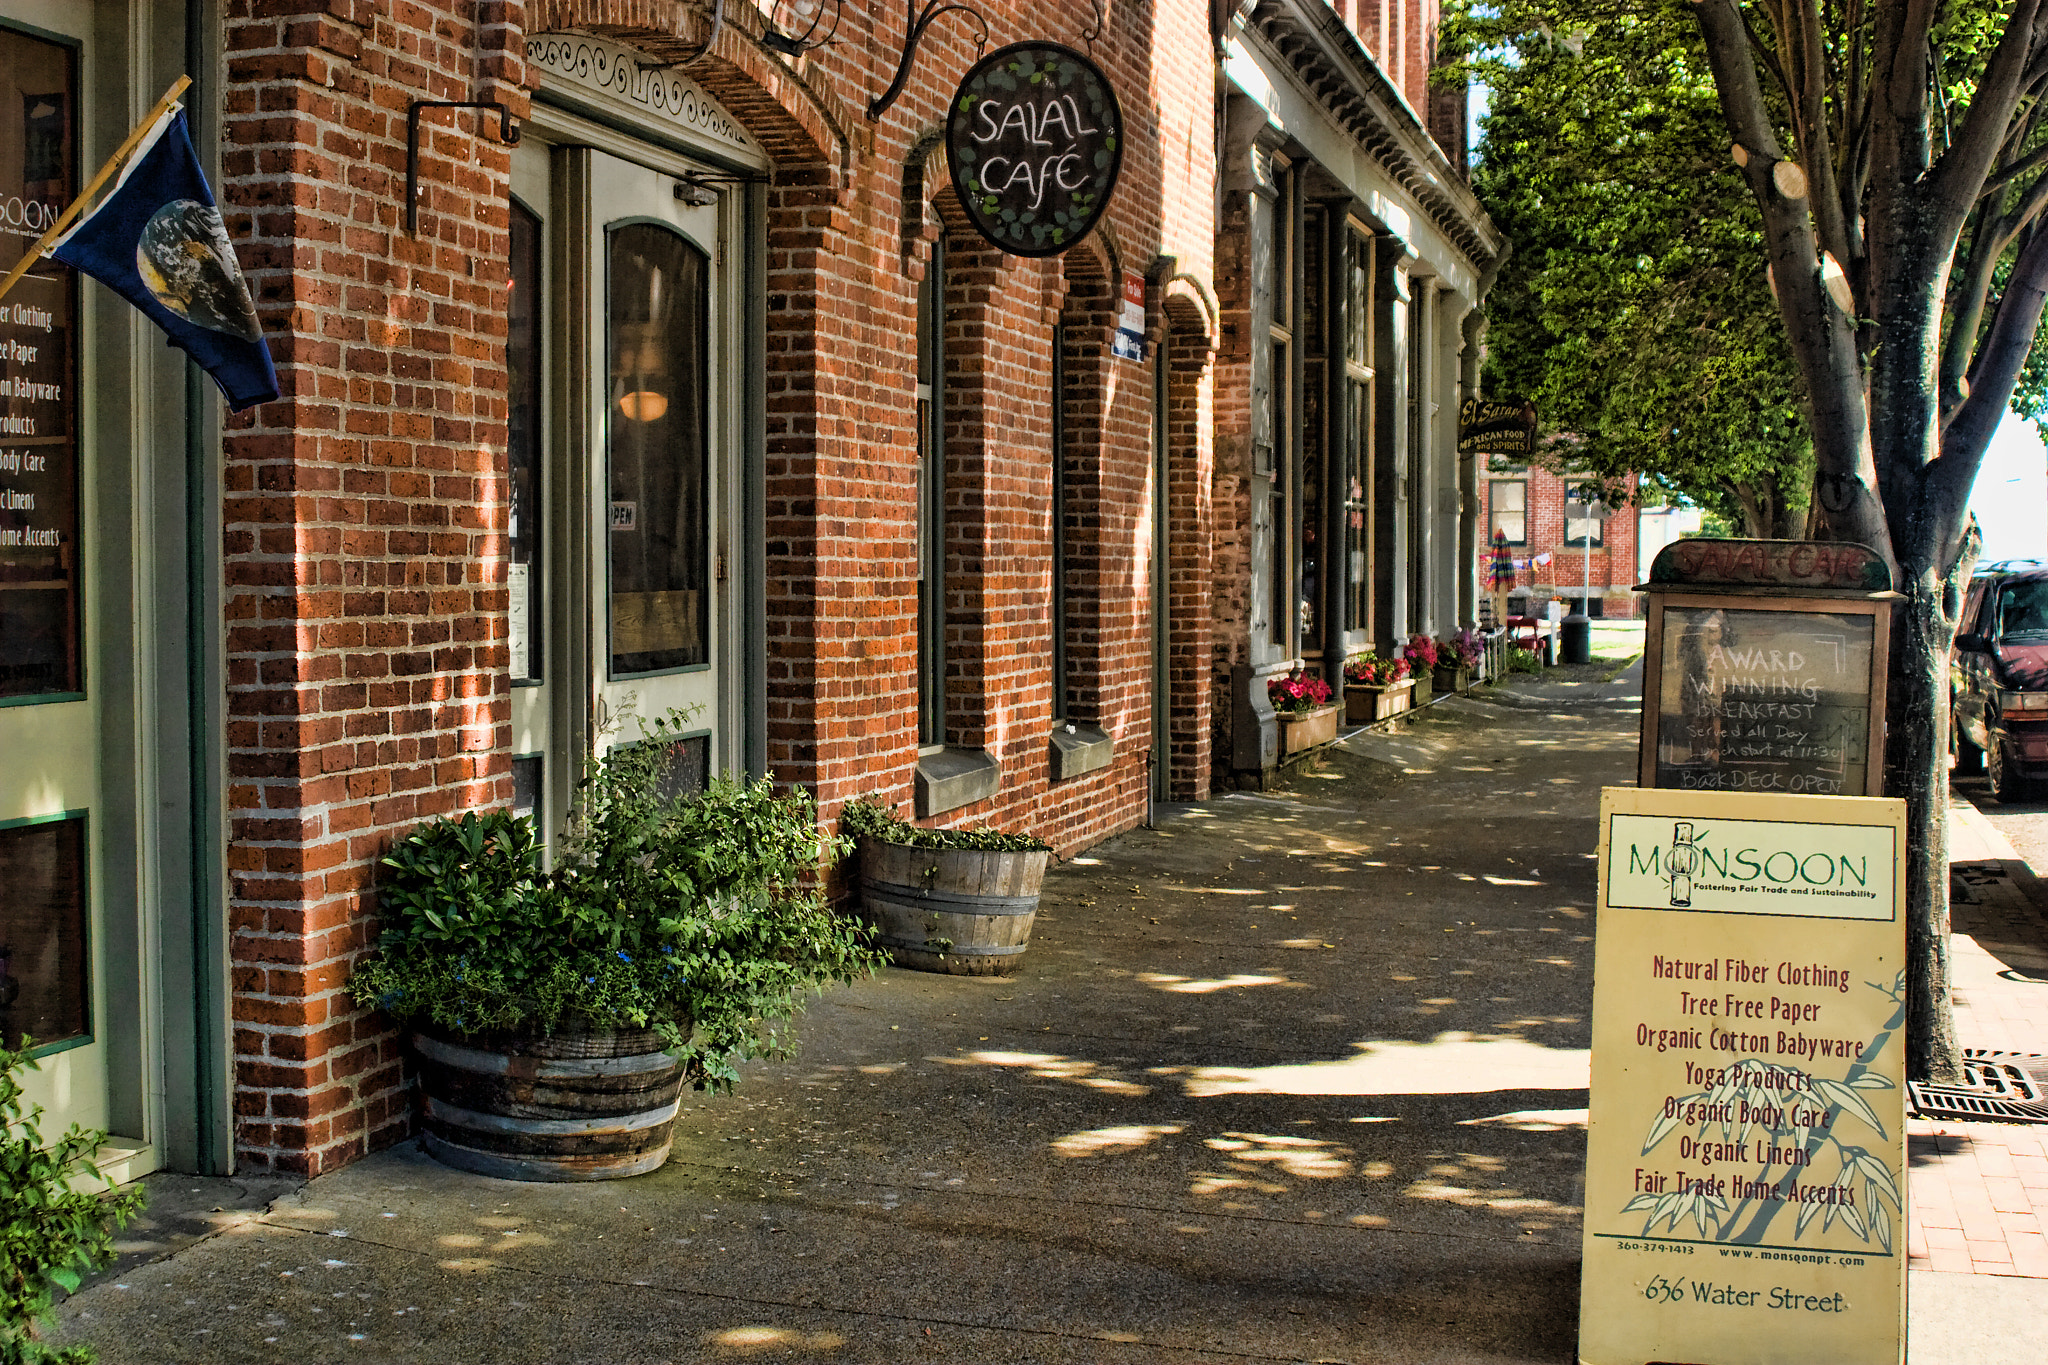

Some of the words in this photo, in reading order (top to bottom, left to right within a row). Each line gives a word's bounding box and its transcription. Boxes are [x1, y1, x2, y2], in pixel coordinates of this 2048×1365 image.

[971, 94, 1098, 145] SALAL
[13, 303, 52, 333] Clothing
[10, 338, 38, 366] Paper
[14, 376, 61, 403] Babyware
[1461, 400, 1478, 426] El
[1460, 431, 1502, 450] MEXICAN
[1504, 429, 1525, 440] FOOD
[1493, 441, 1525, 451] SPIRITS
[24, 450, 46, 472] Care
[7, 488, 35, 510] Linens
[610, 507, 632, 525] PEN
[0, 525, 22, 546] ome
[25, 525, 60, 547] Accents
[1680, 543, 1775, 580] SALAL
[1708, 644, 1805, 672] AWARD
[1689, 673, 1824, 702] WINNING
[1696, 701, 1816, 720] BREAKFAST
[1686, 724, 1741, 738] Served
[1748, 724, 1765, 737] all
[1775, 724, 1808, 745] Day
[1780, 745, 1794, 757] at
[1801, 745, 1840, 758] 11:30
[1790, 774, 1841, 793] OPEN
[1629, 843, 1867, 887] MONSOON
[1693, 882, 1736, 893] Fostering
[1739, 884, 1758, 893] Fair
[1761, 886, 1788, 894] Trade
[1790, 887, 1808, 895] and
[1811, 888, 1877, 899] Sustainability
[1653, 954, 1718, 981] Natural
[1726, 959, 1769, 984] Fiber
[1777, 962, 1850, 993] Clothing
[1681, 991, 1718, 1016] Tree
[1725, 994, 1764, 1019] Free
[1771, 997, 1821, 1025] Paper
[1637, 1023, 1702, 1052] Organic
[1710, 1028, 1769, 1053] Cotton
[1777, 1031, 1864, 1061] Babyware
[1686, 1061, 1726, 1091] Yoga
[1733, 1065, 1812, 1092] Products
[1664, 1096, 1732, 1125] Organic
[1740, 1100, 1783, 1131] Body
[1791, 1104, 1830, 1129] Care
[1680, 1136, 1748, 1166] Organic
[1757, 1140, 1811, 1167] Linens
[1635, 1168, 1667, 1194] Fair
[1676, 1171, 1725, 1198] Trade
[1732, 1175, 1780, 1200] Home
[1788, 1179, 1855, 1206] Accents
[1645, 1274, 1686, 1304] 636
[1691, 1281, 1760, 1307] Water
[1767, 1286, 1843, 1313] Street
